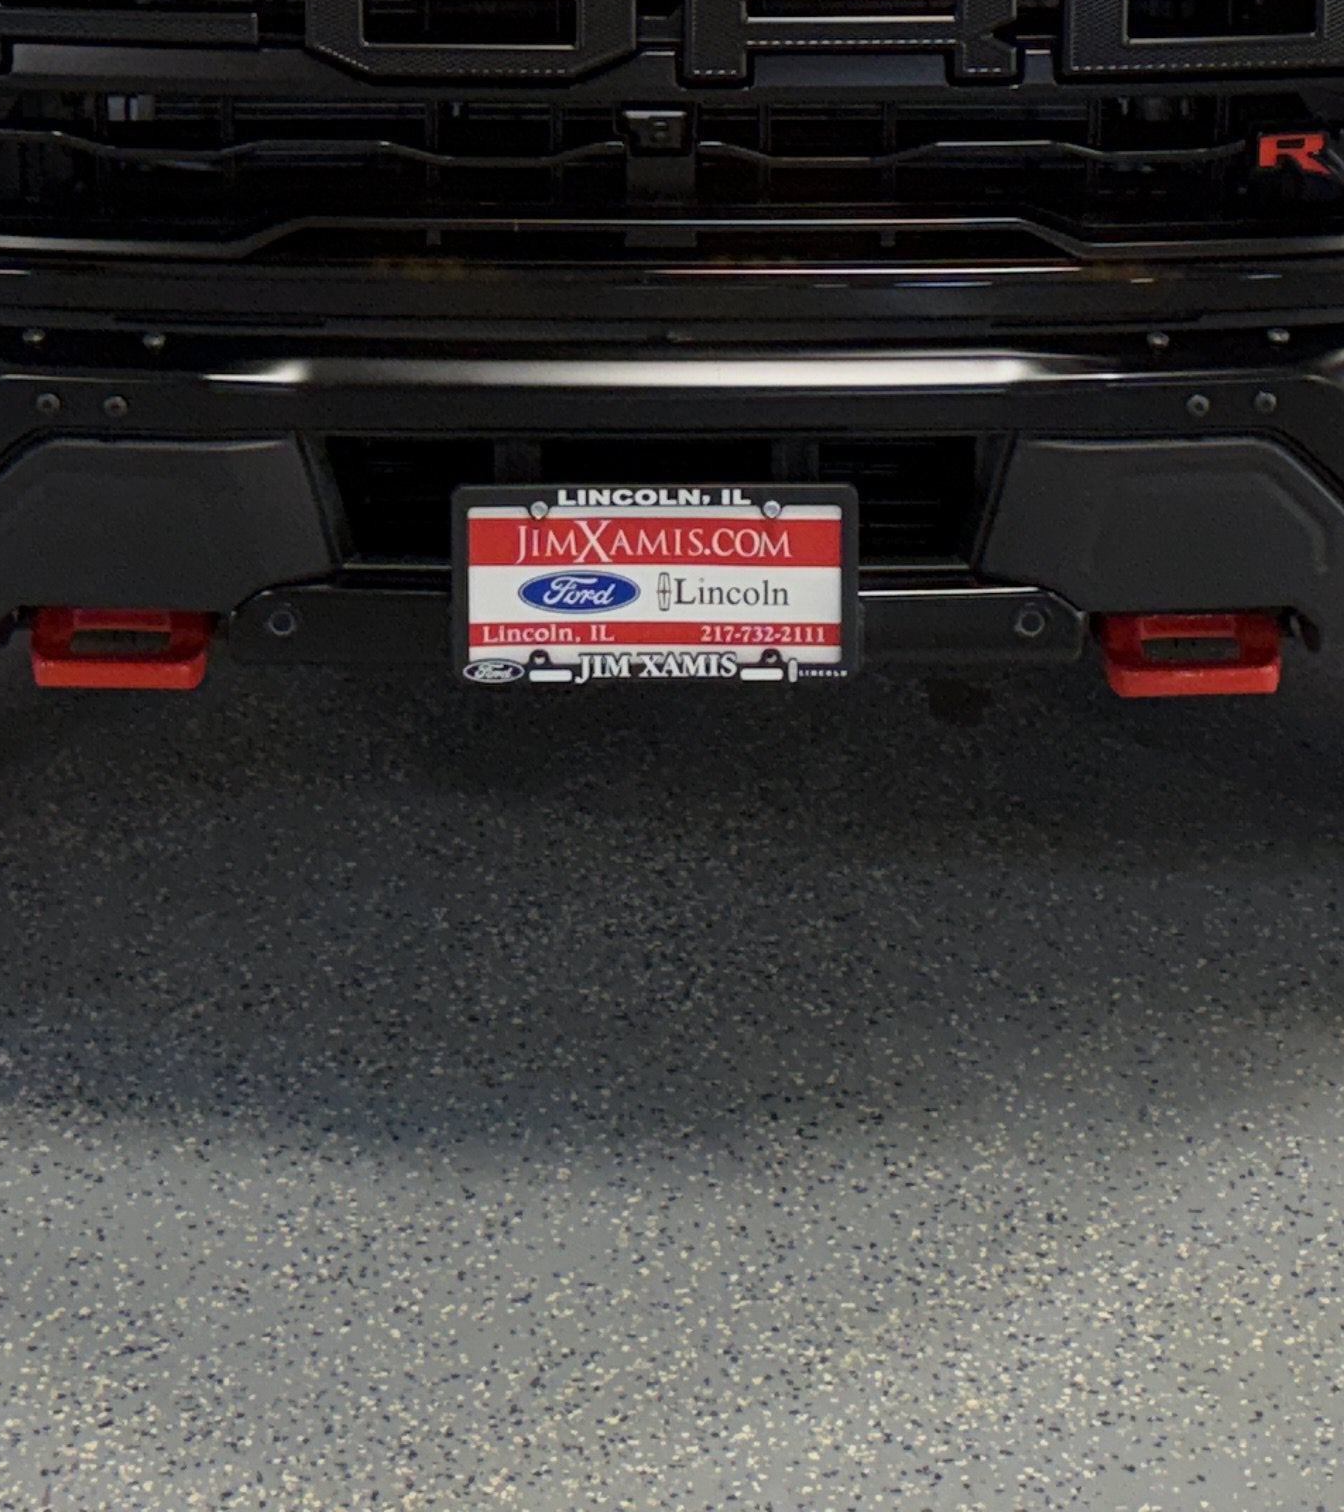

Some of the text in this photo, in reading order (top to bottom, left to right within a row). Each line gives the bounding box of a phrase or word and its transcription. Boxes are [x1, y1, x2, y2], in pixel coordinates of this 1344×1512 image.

[1259, 132, 1332, 175] R
[557, 488, 752, 506] LINCOLN, IL
[516, 519, 792, 563] JIMXAMIS.COM
[543, 576, 616, 605] Ford
[674, 578, 790, 606] Lincoln
[482, 624, 616, 645] Lincoln, IL
[701, 625, 826, 643] 217-732-2111
[575, 652, 739, 684] JIM XAMIS
